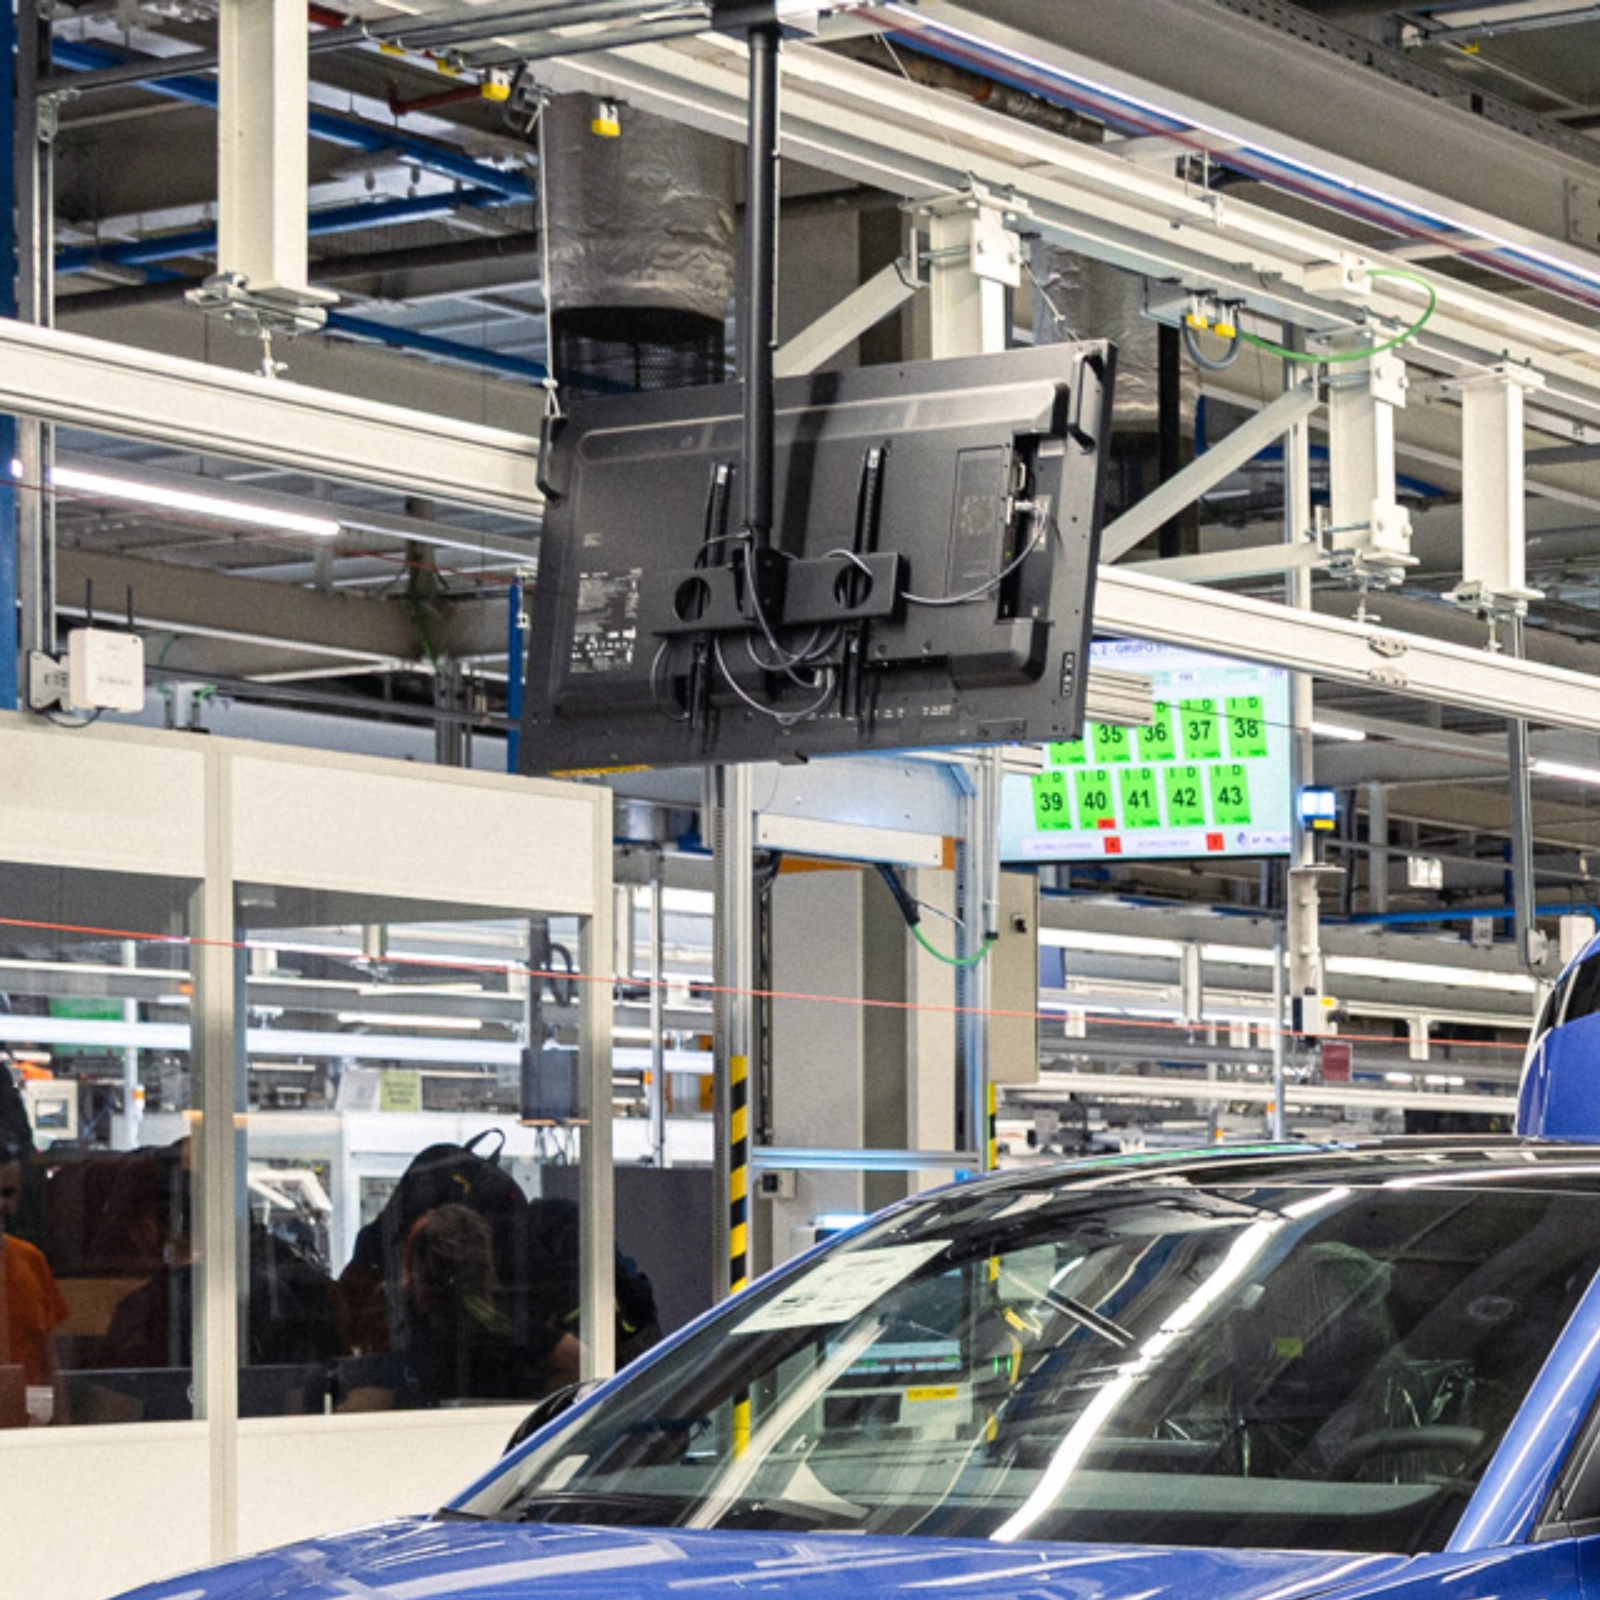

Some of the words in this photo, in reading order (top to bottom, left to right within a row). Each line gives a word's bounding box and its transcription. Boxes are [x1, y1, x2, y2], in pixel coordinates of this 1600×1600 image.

[1100, 723, 1123, 743] 35
[1144, 722, 1167, 743] 36
[1188, 720, 1211, 740] 37
[1235, 717, 1258, 738] 38
[1039, 792, 1063, 812] 39
[1083, 790, 1106, 810] 40
[1127, 789, 1150, 809] 41
[1172, 787, 1196, 807] 42
[1217, 785, 1242, 806] 43
